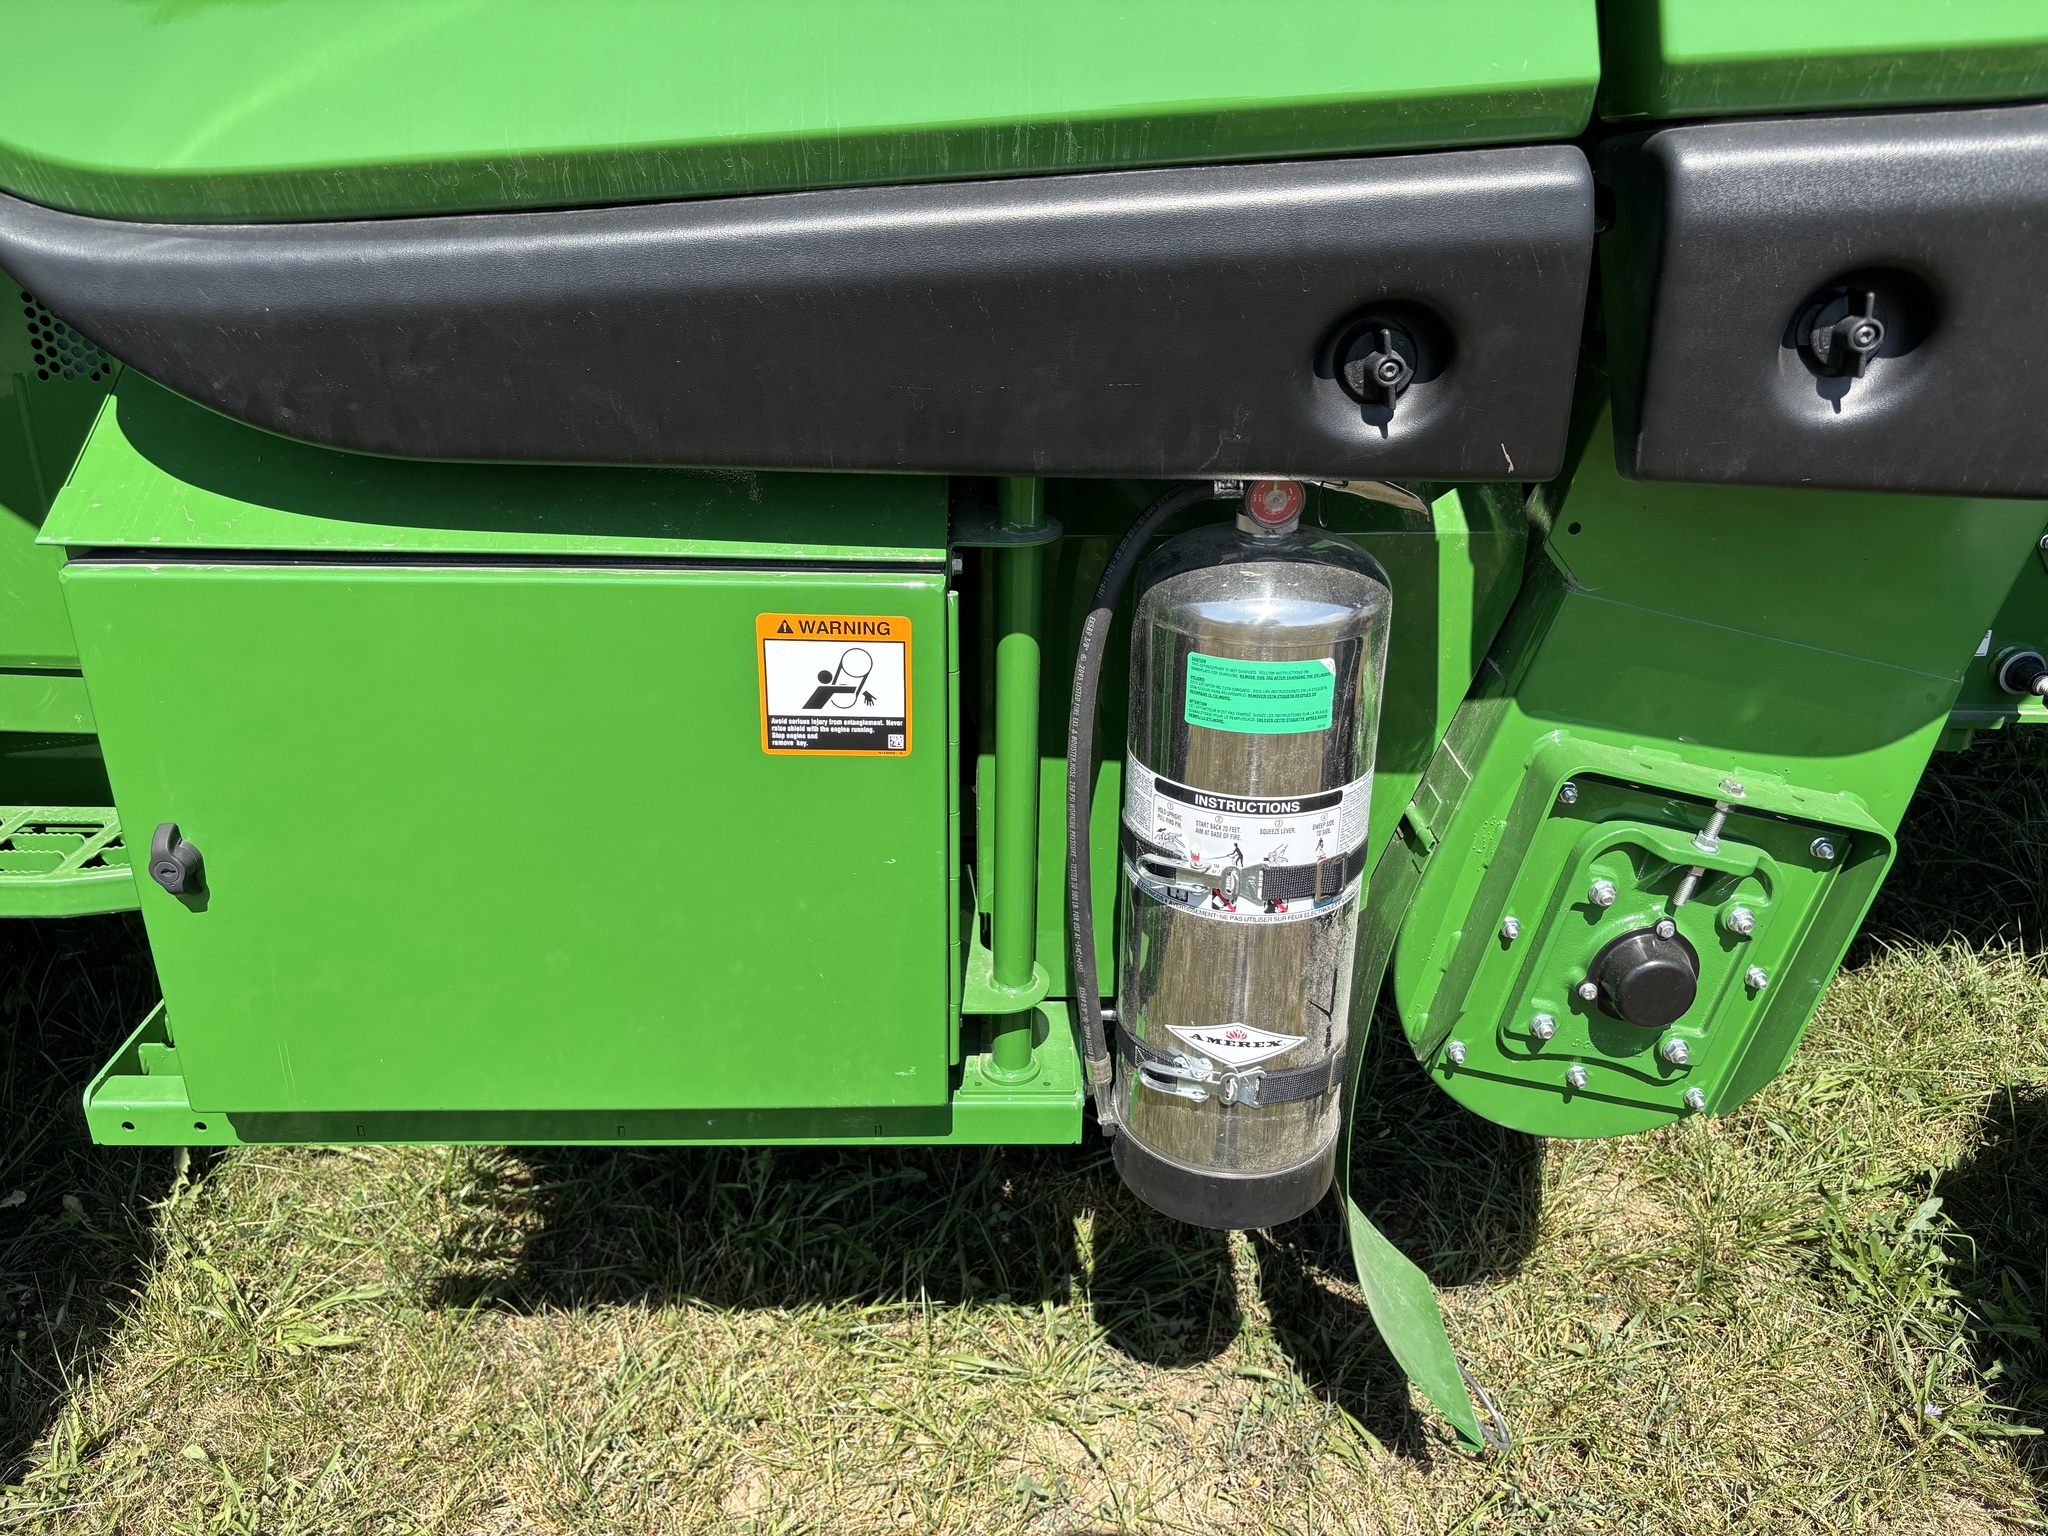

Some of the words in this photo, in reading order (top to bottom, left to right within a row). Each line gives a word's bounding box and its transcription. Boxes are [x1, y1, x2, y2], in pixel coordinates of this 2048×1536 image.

[1127, 525, 1138, 538] FOR
[1120, 537, 1130, 552] USE
[1114, 550, 1122, 560] AT
[798, 620, 890, 636] WARNING
[1074, 682, 1082, 702] LISTED
[1158, 806, 1166, 815] HOLD
[1195, 794, 1300, 814] INSTRUCTIONS
[1196, 820, 1209, 828] START
[1312, 822, 1326, 830] SWEEP
[1326, 819, 1335, 827] SIDE
[1071, 882, 1078, 890] TO
[1169, 900, 1218, 918] AVERTISSEMENT:
[1189, 1034, 1283, 1048] AMEREX
